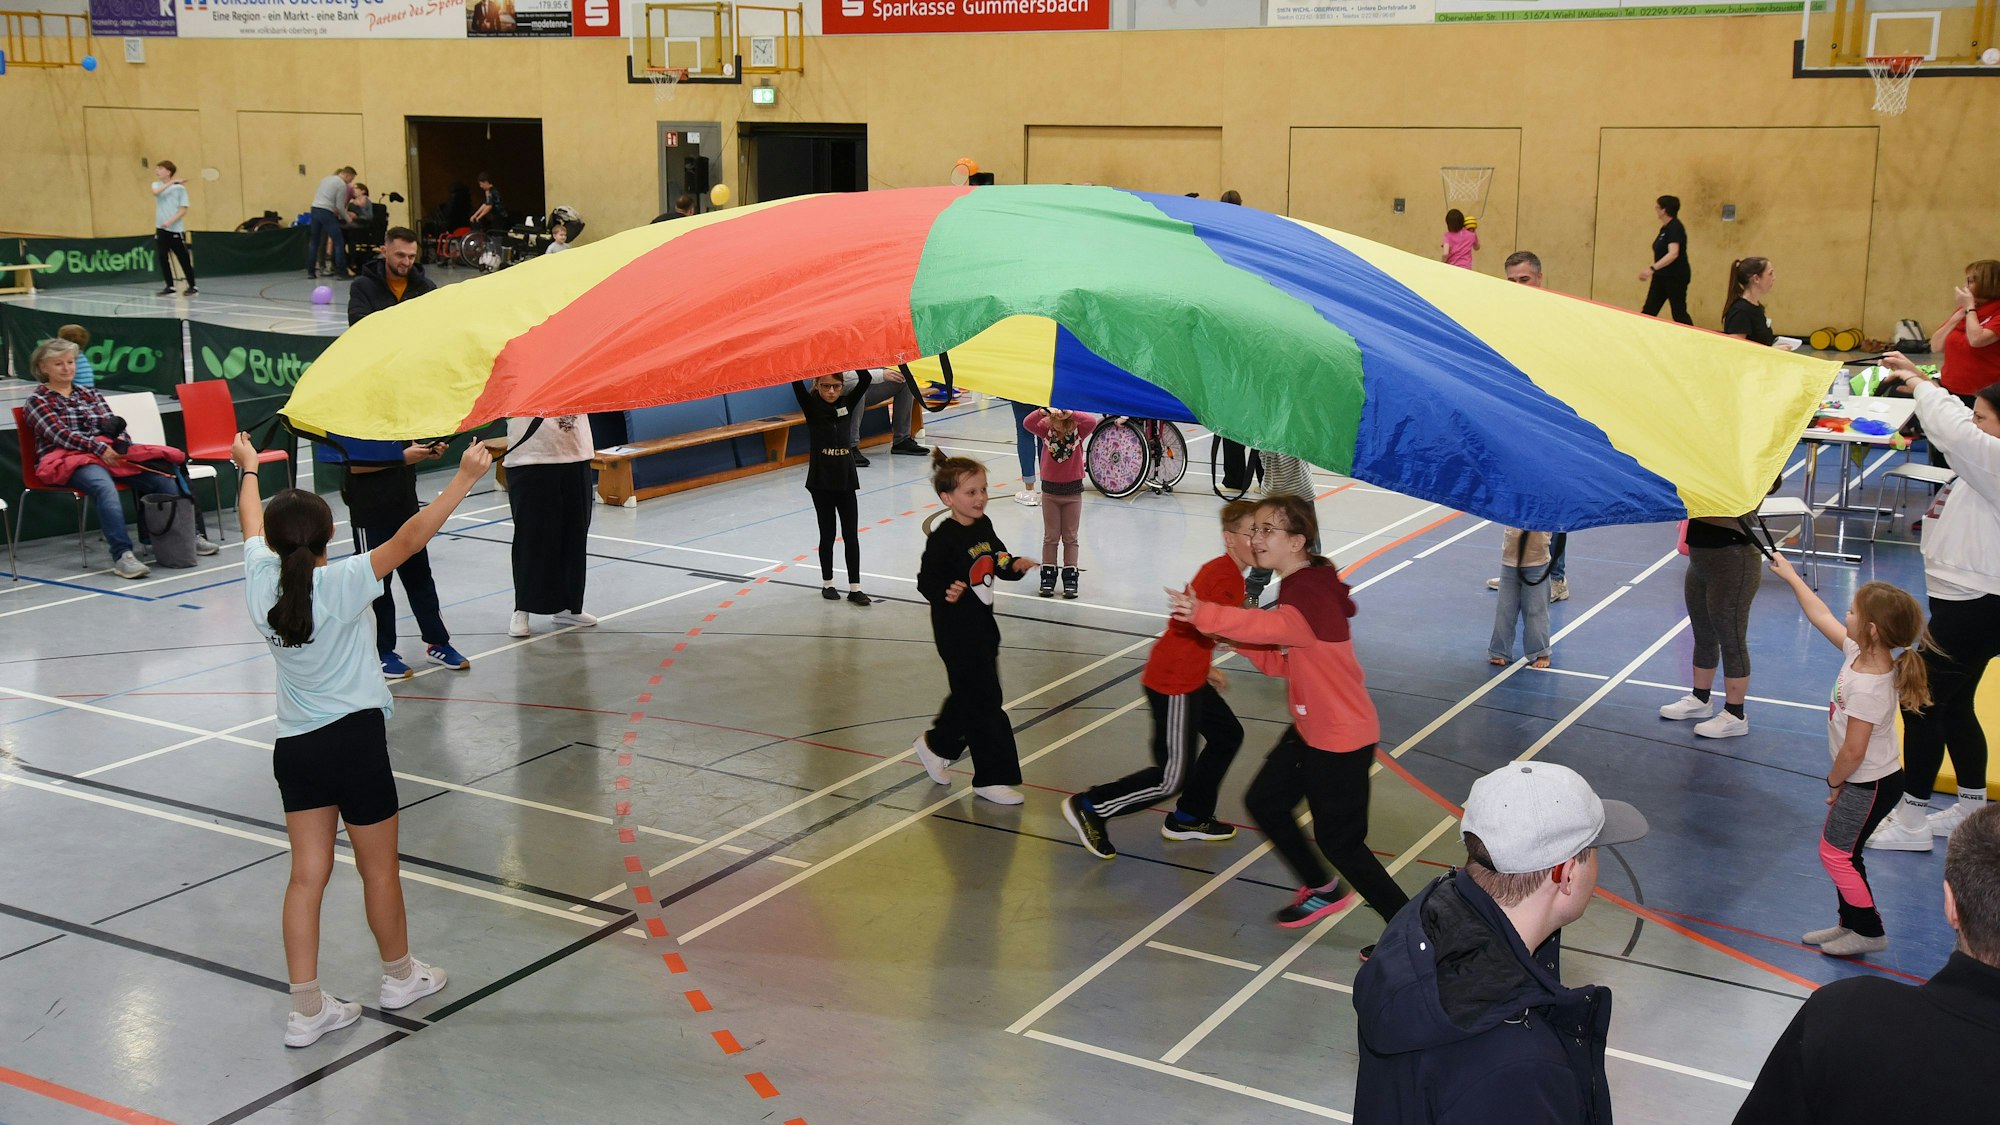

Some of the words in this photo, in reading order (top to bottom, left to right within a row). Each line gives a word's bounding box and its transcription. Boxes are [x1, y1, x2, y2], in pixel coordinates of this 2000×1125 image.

[212, 11, 230, 21] Eine
[232, 11, 261, 23] Region
[268, 11, 281, 21] ein
[283, 11, 309, 21] Markt
[316, 11, 335, 21] eine
[337, 10, 359, 21] Bank
[365, 10, 406, 31] Partner
[409, 4, 424, 17] des
[872, 0, 956, 21] Sparkasse
[962, 0, 1089, 16] Gummersbach
[1438, 13, 1484, 22] Oberwiehler
[1501, 12, 1515, 20] 111
[1523, 12, 1550, 20] 51674
[1553, 11, 1575, 19] Wiehl
[1640, 7, 1669, 16] 02296
[531, 19, 568, 29] modetenne
[67, 246, 155, 273] Butterfly
